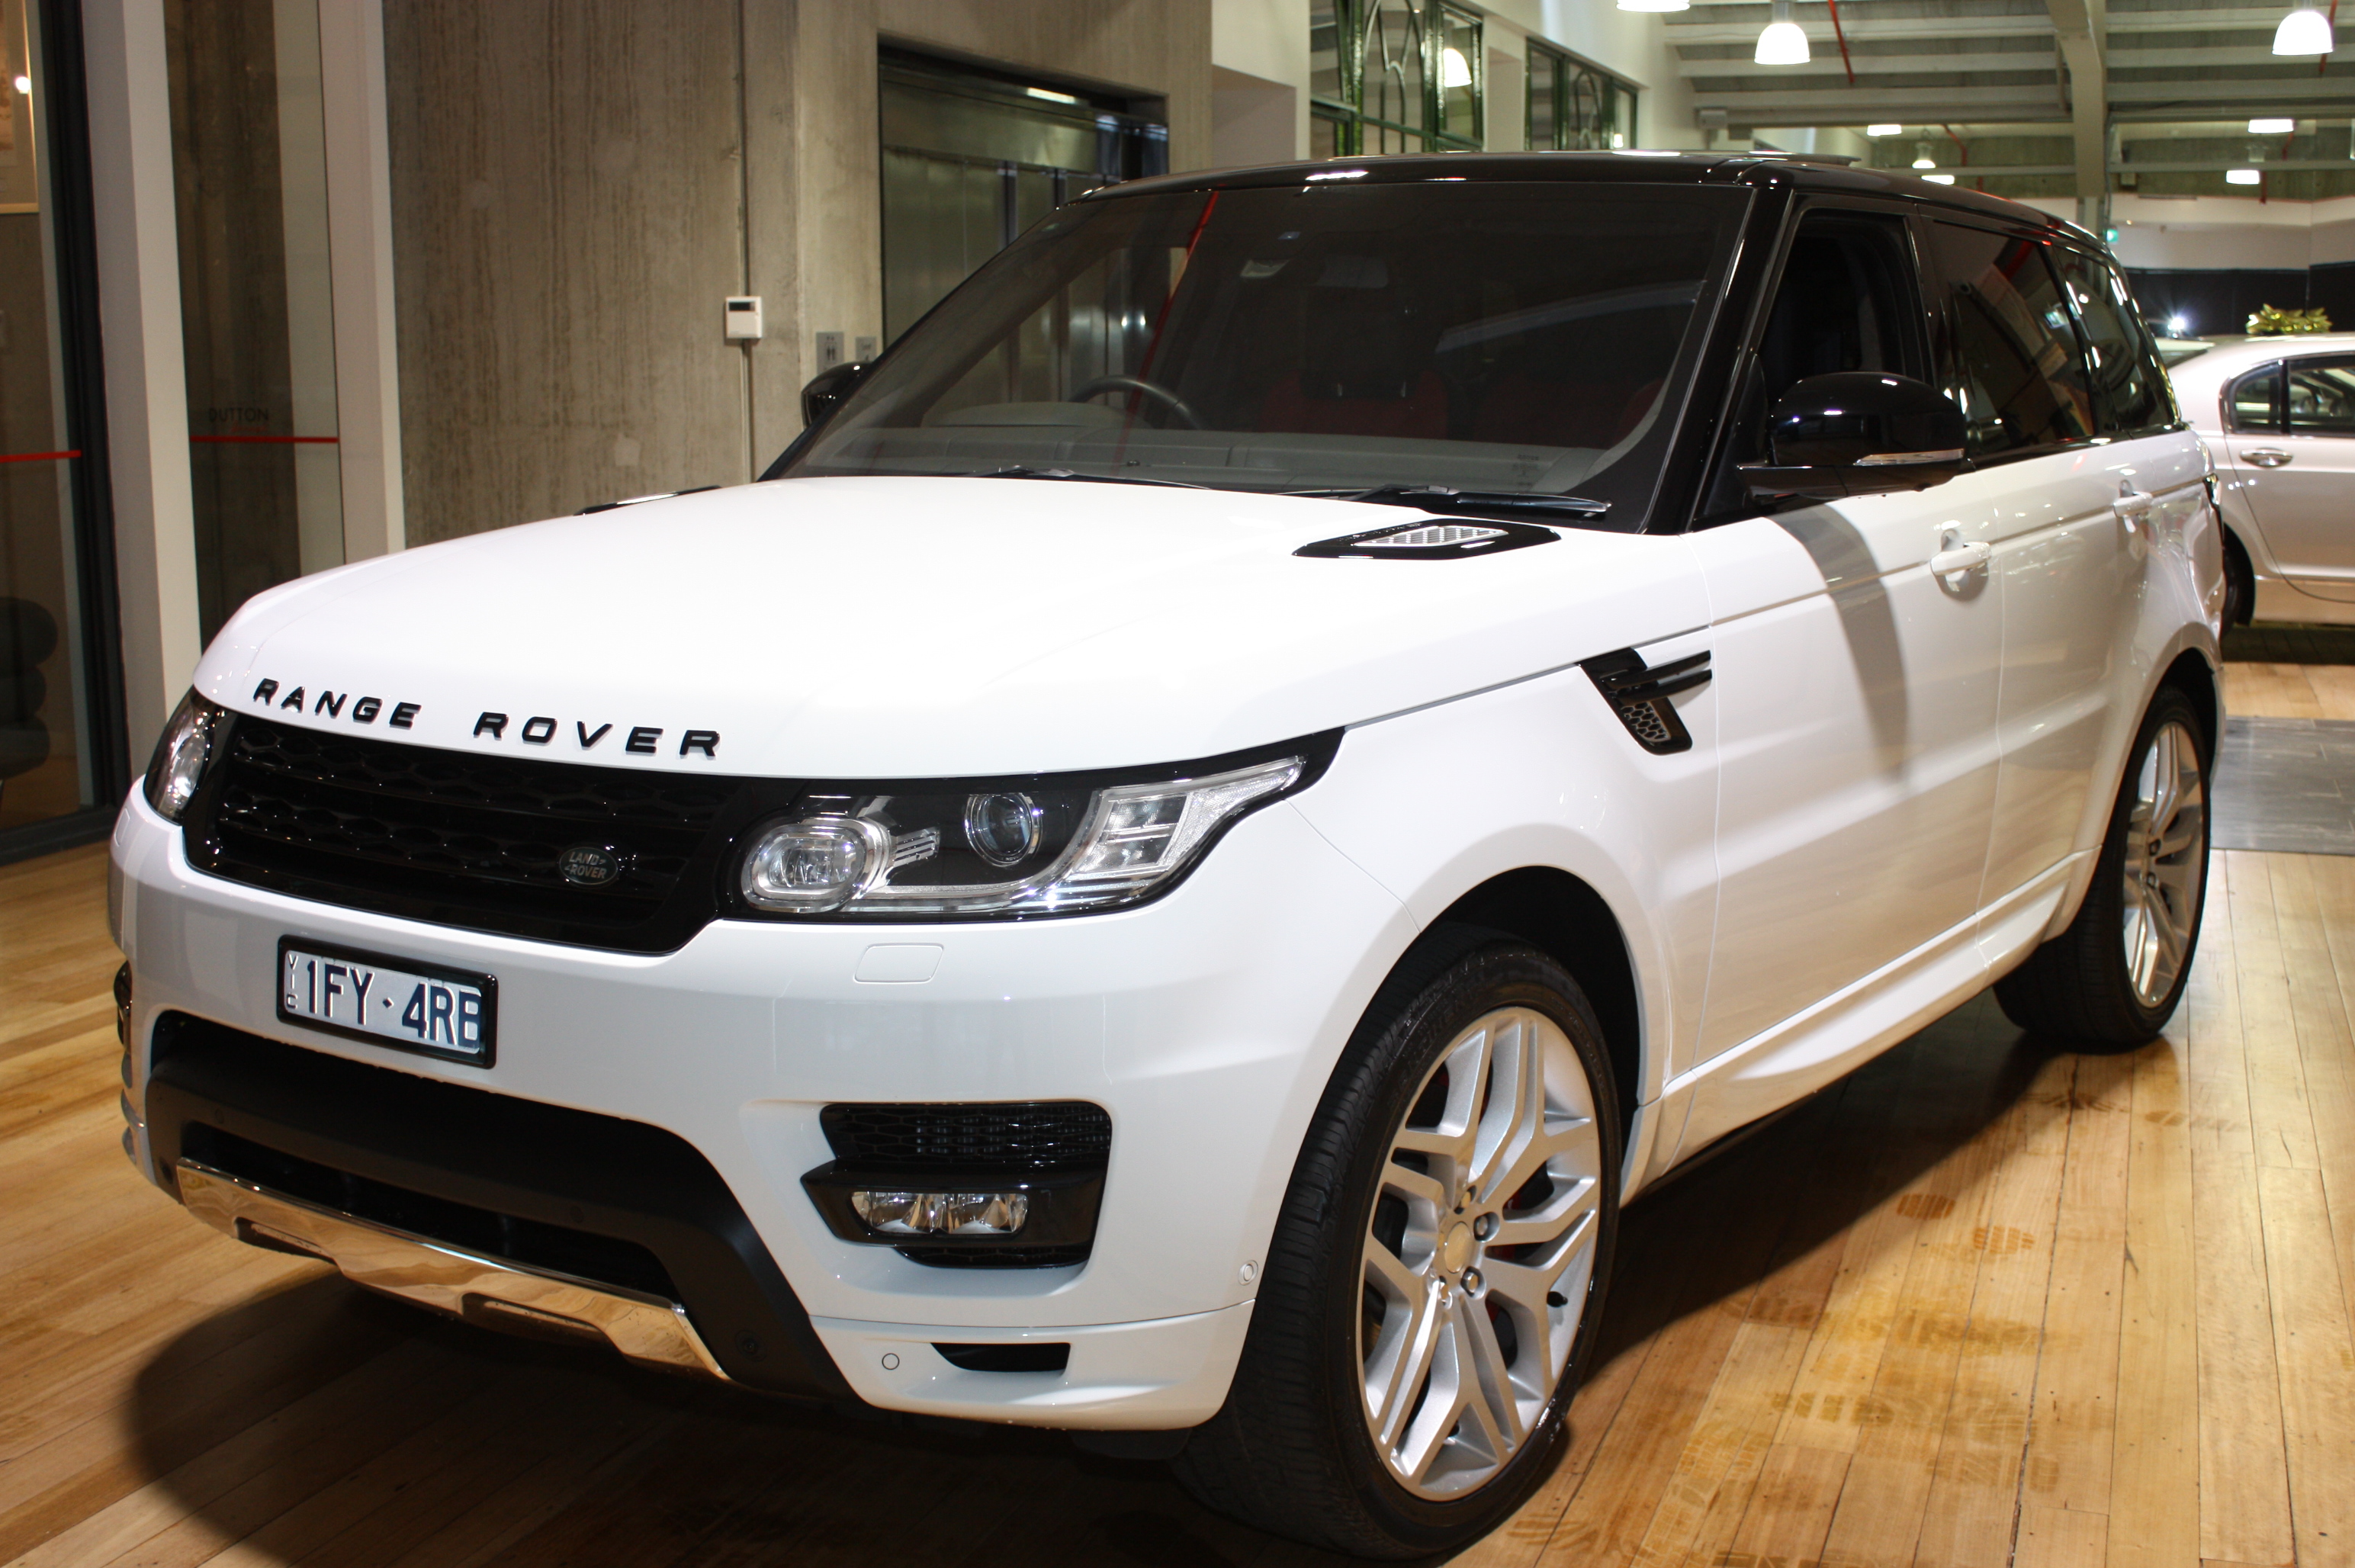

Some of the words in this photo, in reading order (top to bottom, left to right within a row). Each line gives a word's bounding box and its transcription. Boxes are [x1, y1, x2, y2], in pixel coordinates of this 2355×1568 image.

[208, 407, 268, 422] DUTTON
[253, 678, 422, 728] RANGE
[473, 712, 721, 757] ROVER
[569, 851, 599, 865] LAND
[569, 863, 607, 879] ROVER
